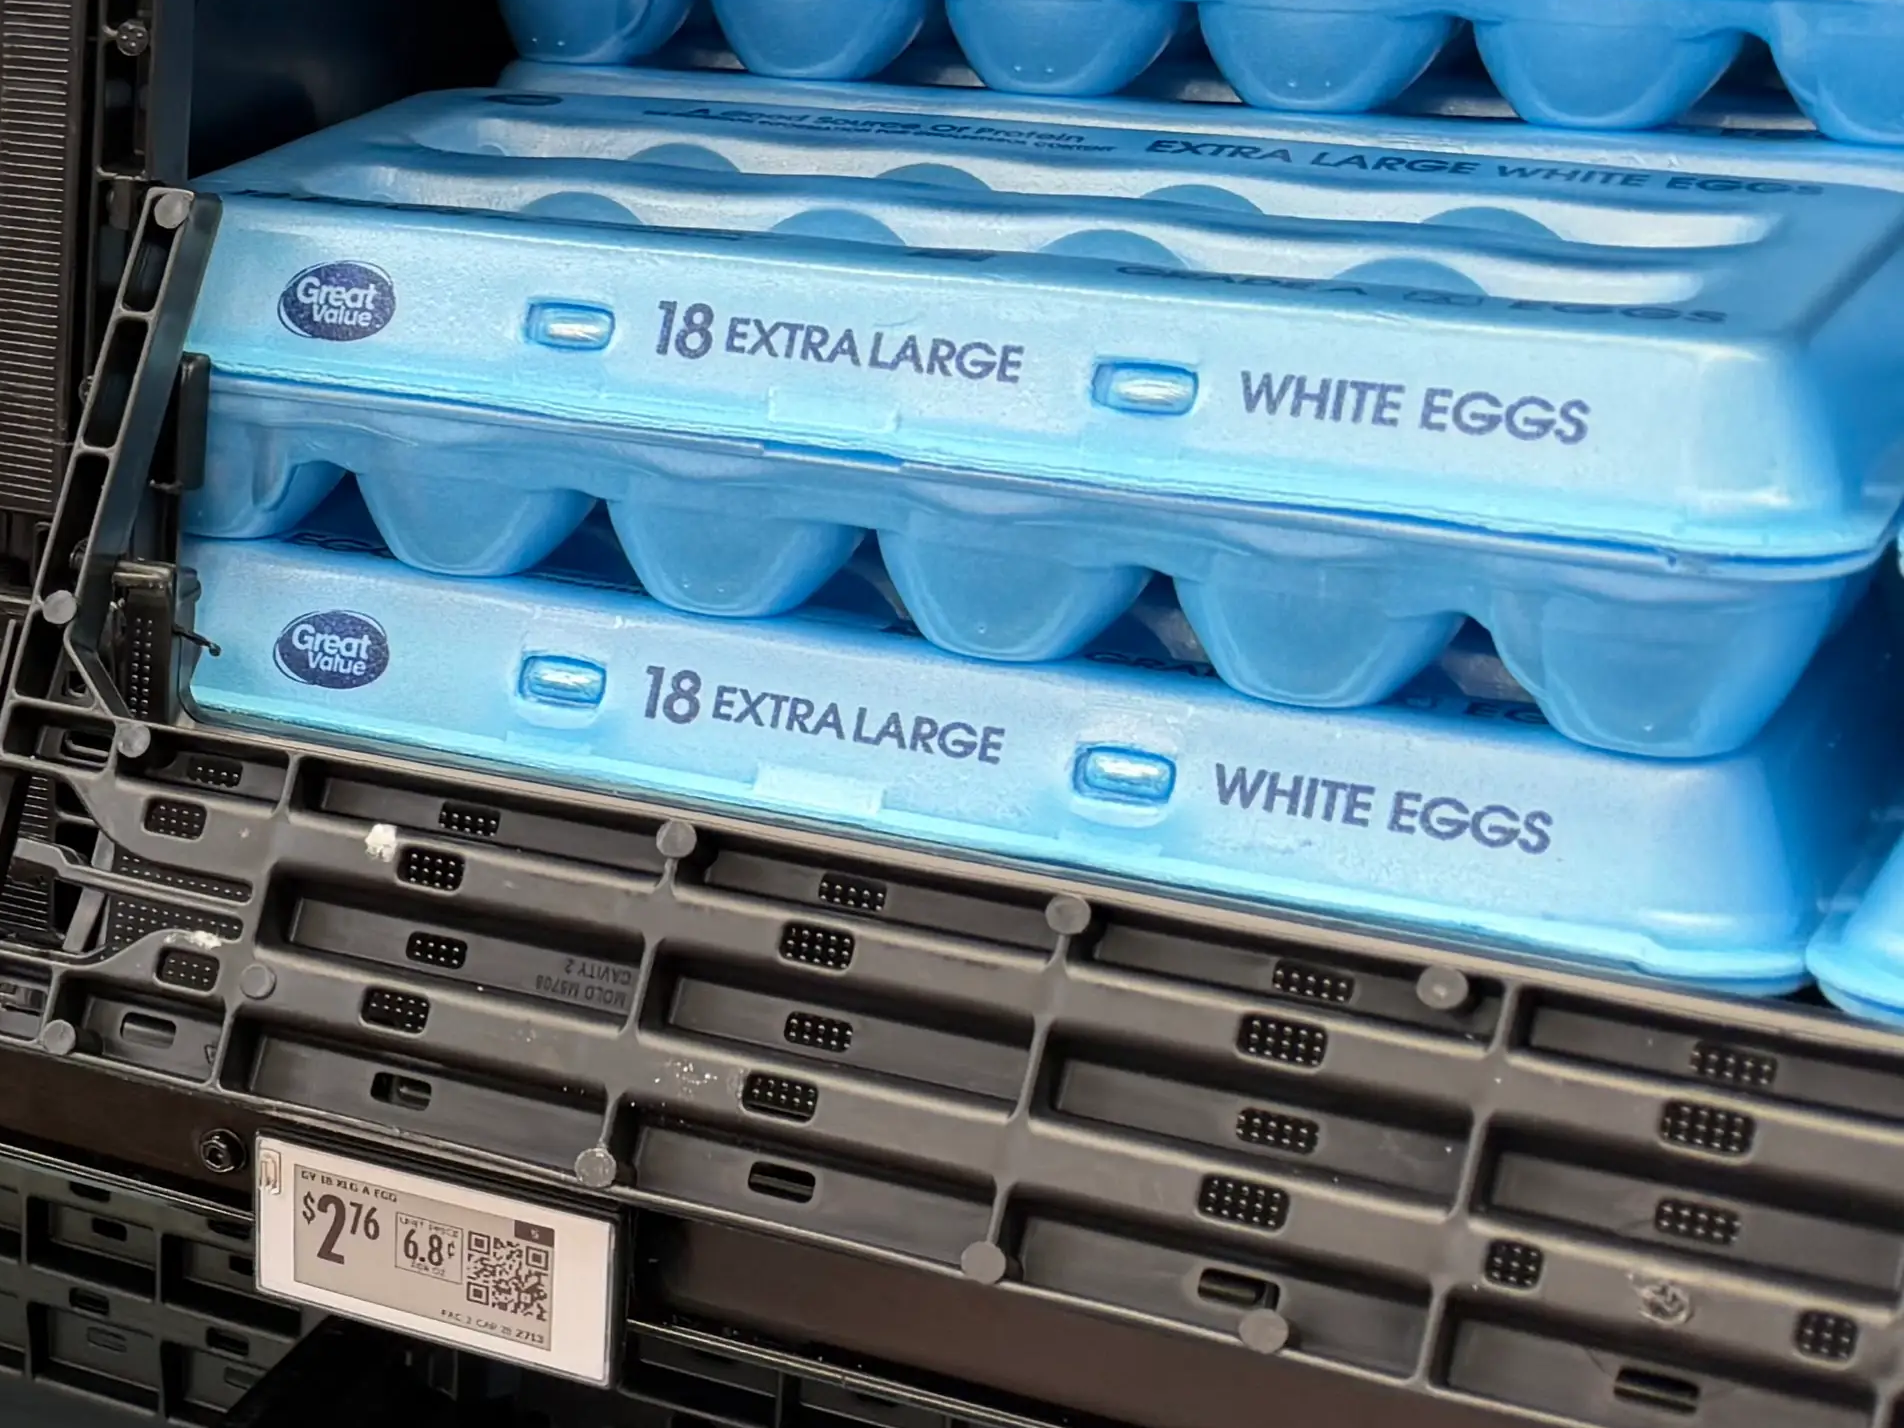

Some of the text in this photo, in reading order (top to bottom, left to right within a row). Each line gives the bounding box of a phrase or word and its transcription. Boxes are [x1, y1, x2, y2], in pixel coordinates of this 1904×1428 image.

[1145, 139, 1823, 196] EXTRA LARGE WHITE EGGS
[294, 278, 377, 311] Great
[311, 303, 373, 329] Value
[655, 301, 1591, 445] 18 EXTRA LARGE WHITE EGGS
[644, 665, 1554, 854] 18 EXTRA LARGE WHITE EGGS
